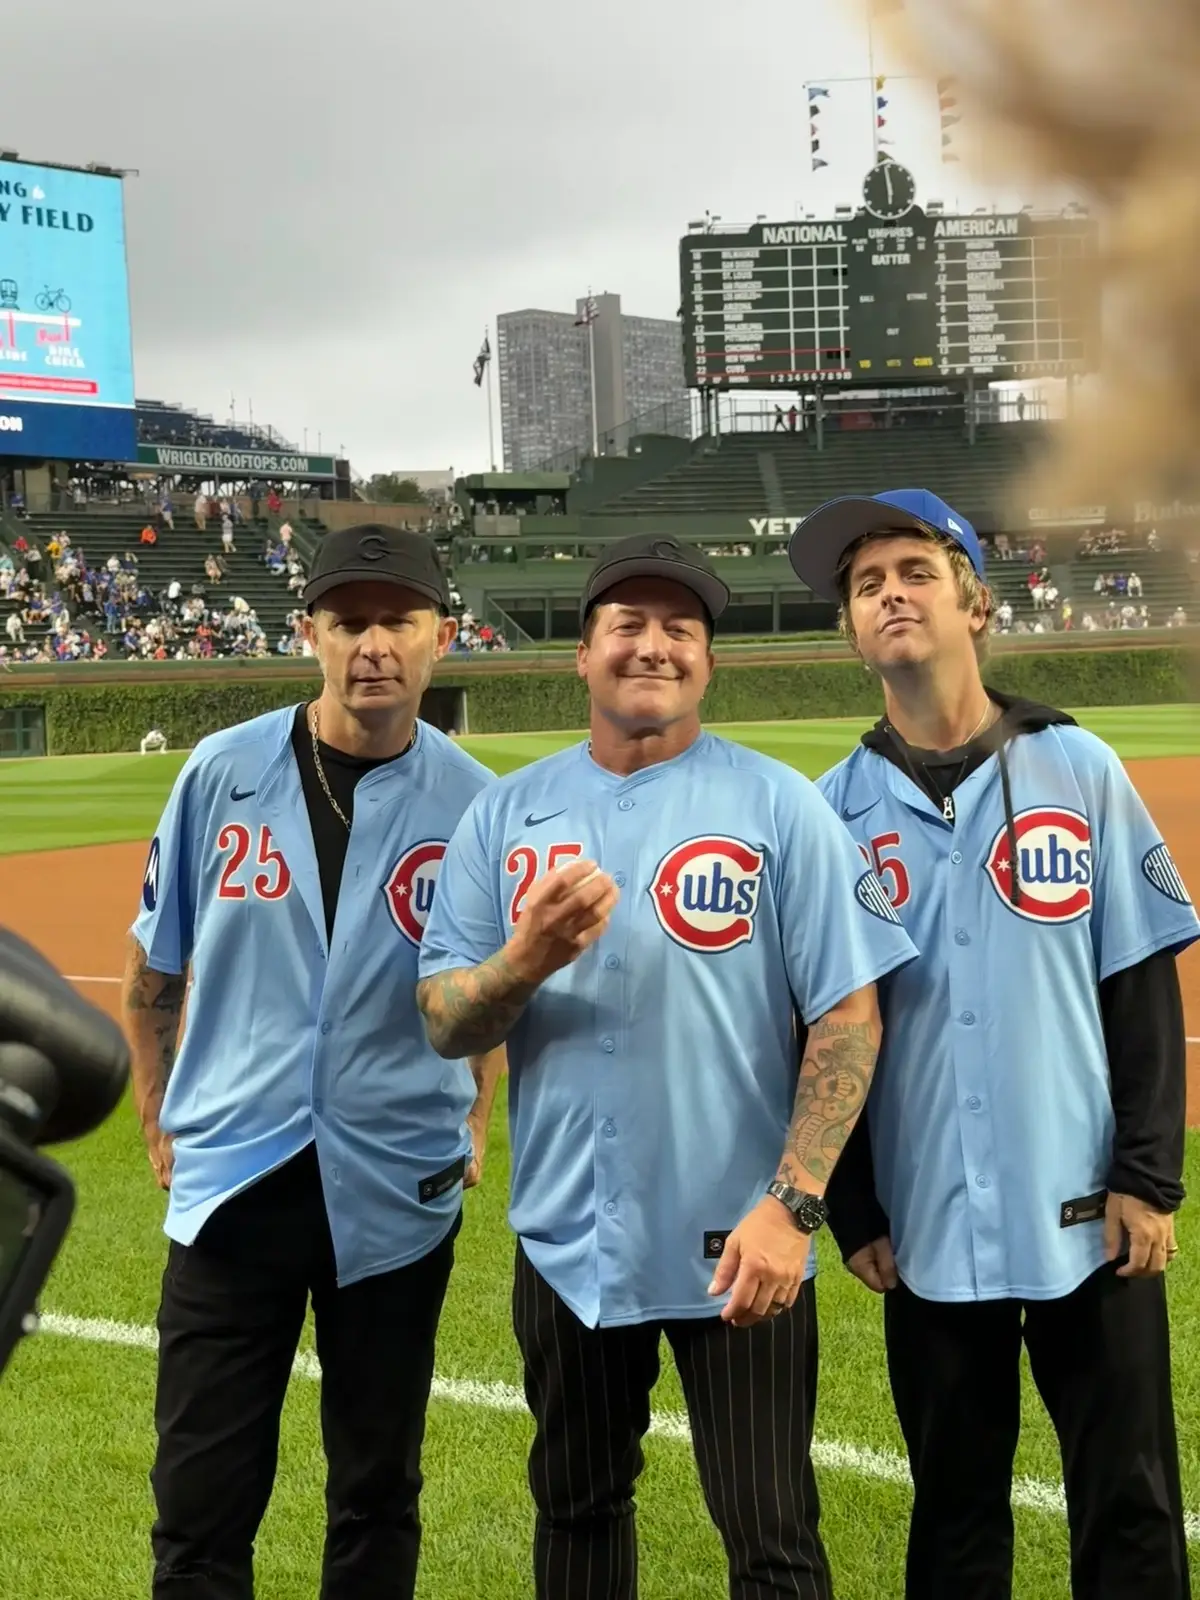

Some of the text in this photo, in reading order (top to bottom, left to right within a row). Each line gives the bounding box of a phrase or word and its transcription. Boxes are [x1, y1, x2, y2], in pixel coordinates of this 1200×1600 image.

[22, 205, 94, 233] FIELD
[762, 225, 848, 244] NATIONAL
[868, 227, 914, 239] UMPIRES
[934, 218, 1018, 237] AMERICAN
[871, 253, 911, 266] BATTER
[748, 516, 807, 536] YET
[217, 823, 293, 901] 25
[505, 841, 584, 926] 2
[856, 831, 911, 909] 5
[981, 805, 1093, 925] Cubs
[380, 838, 450, 949] Cu
[648, 833, 765, 954] Cubs
